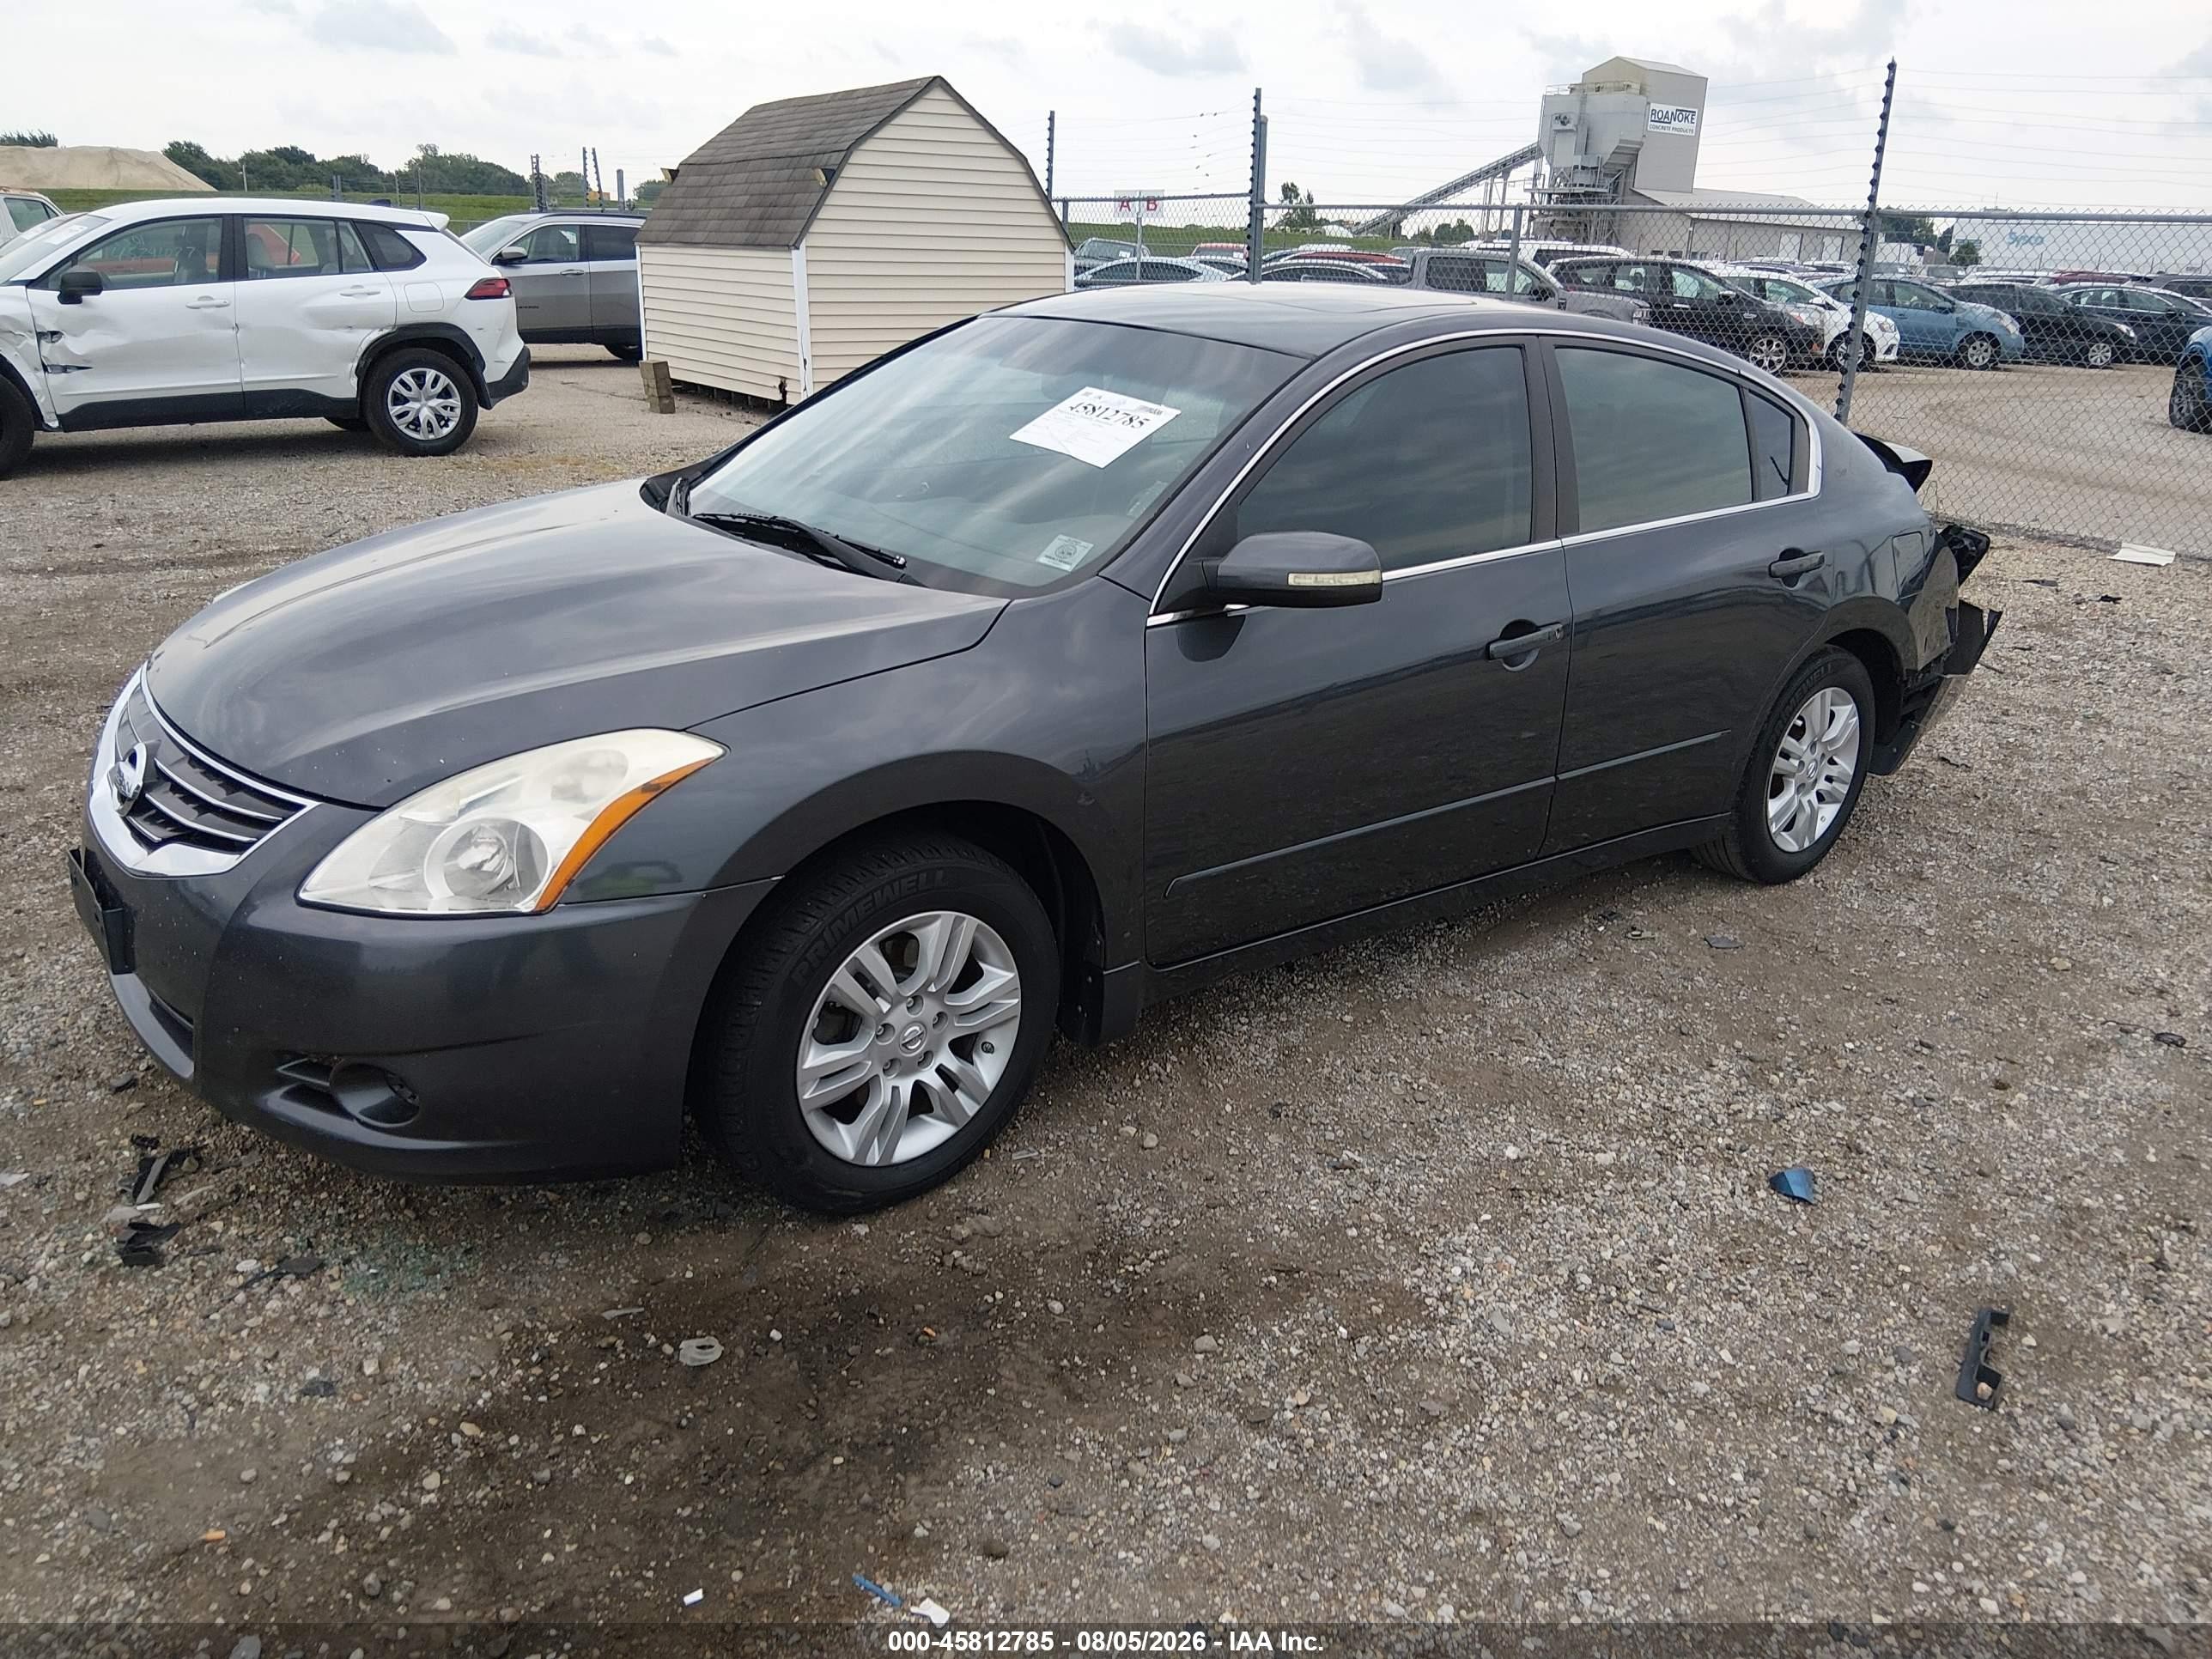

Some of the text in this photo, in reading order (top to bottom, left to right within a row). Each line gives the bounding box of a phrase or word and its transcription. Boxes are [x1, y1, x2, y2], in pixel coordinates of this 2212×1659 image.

[1650, 109, 1696, 124] ROANOKE
[1119, 196, 1131, 211] A
[1146, 196, 1157, 211] B
[790, 869, 948, 987] PRIMEWELL
